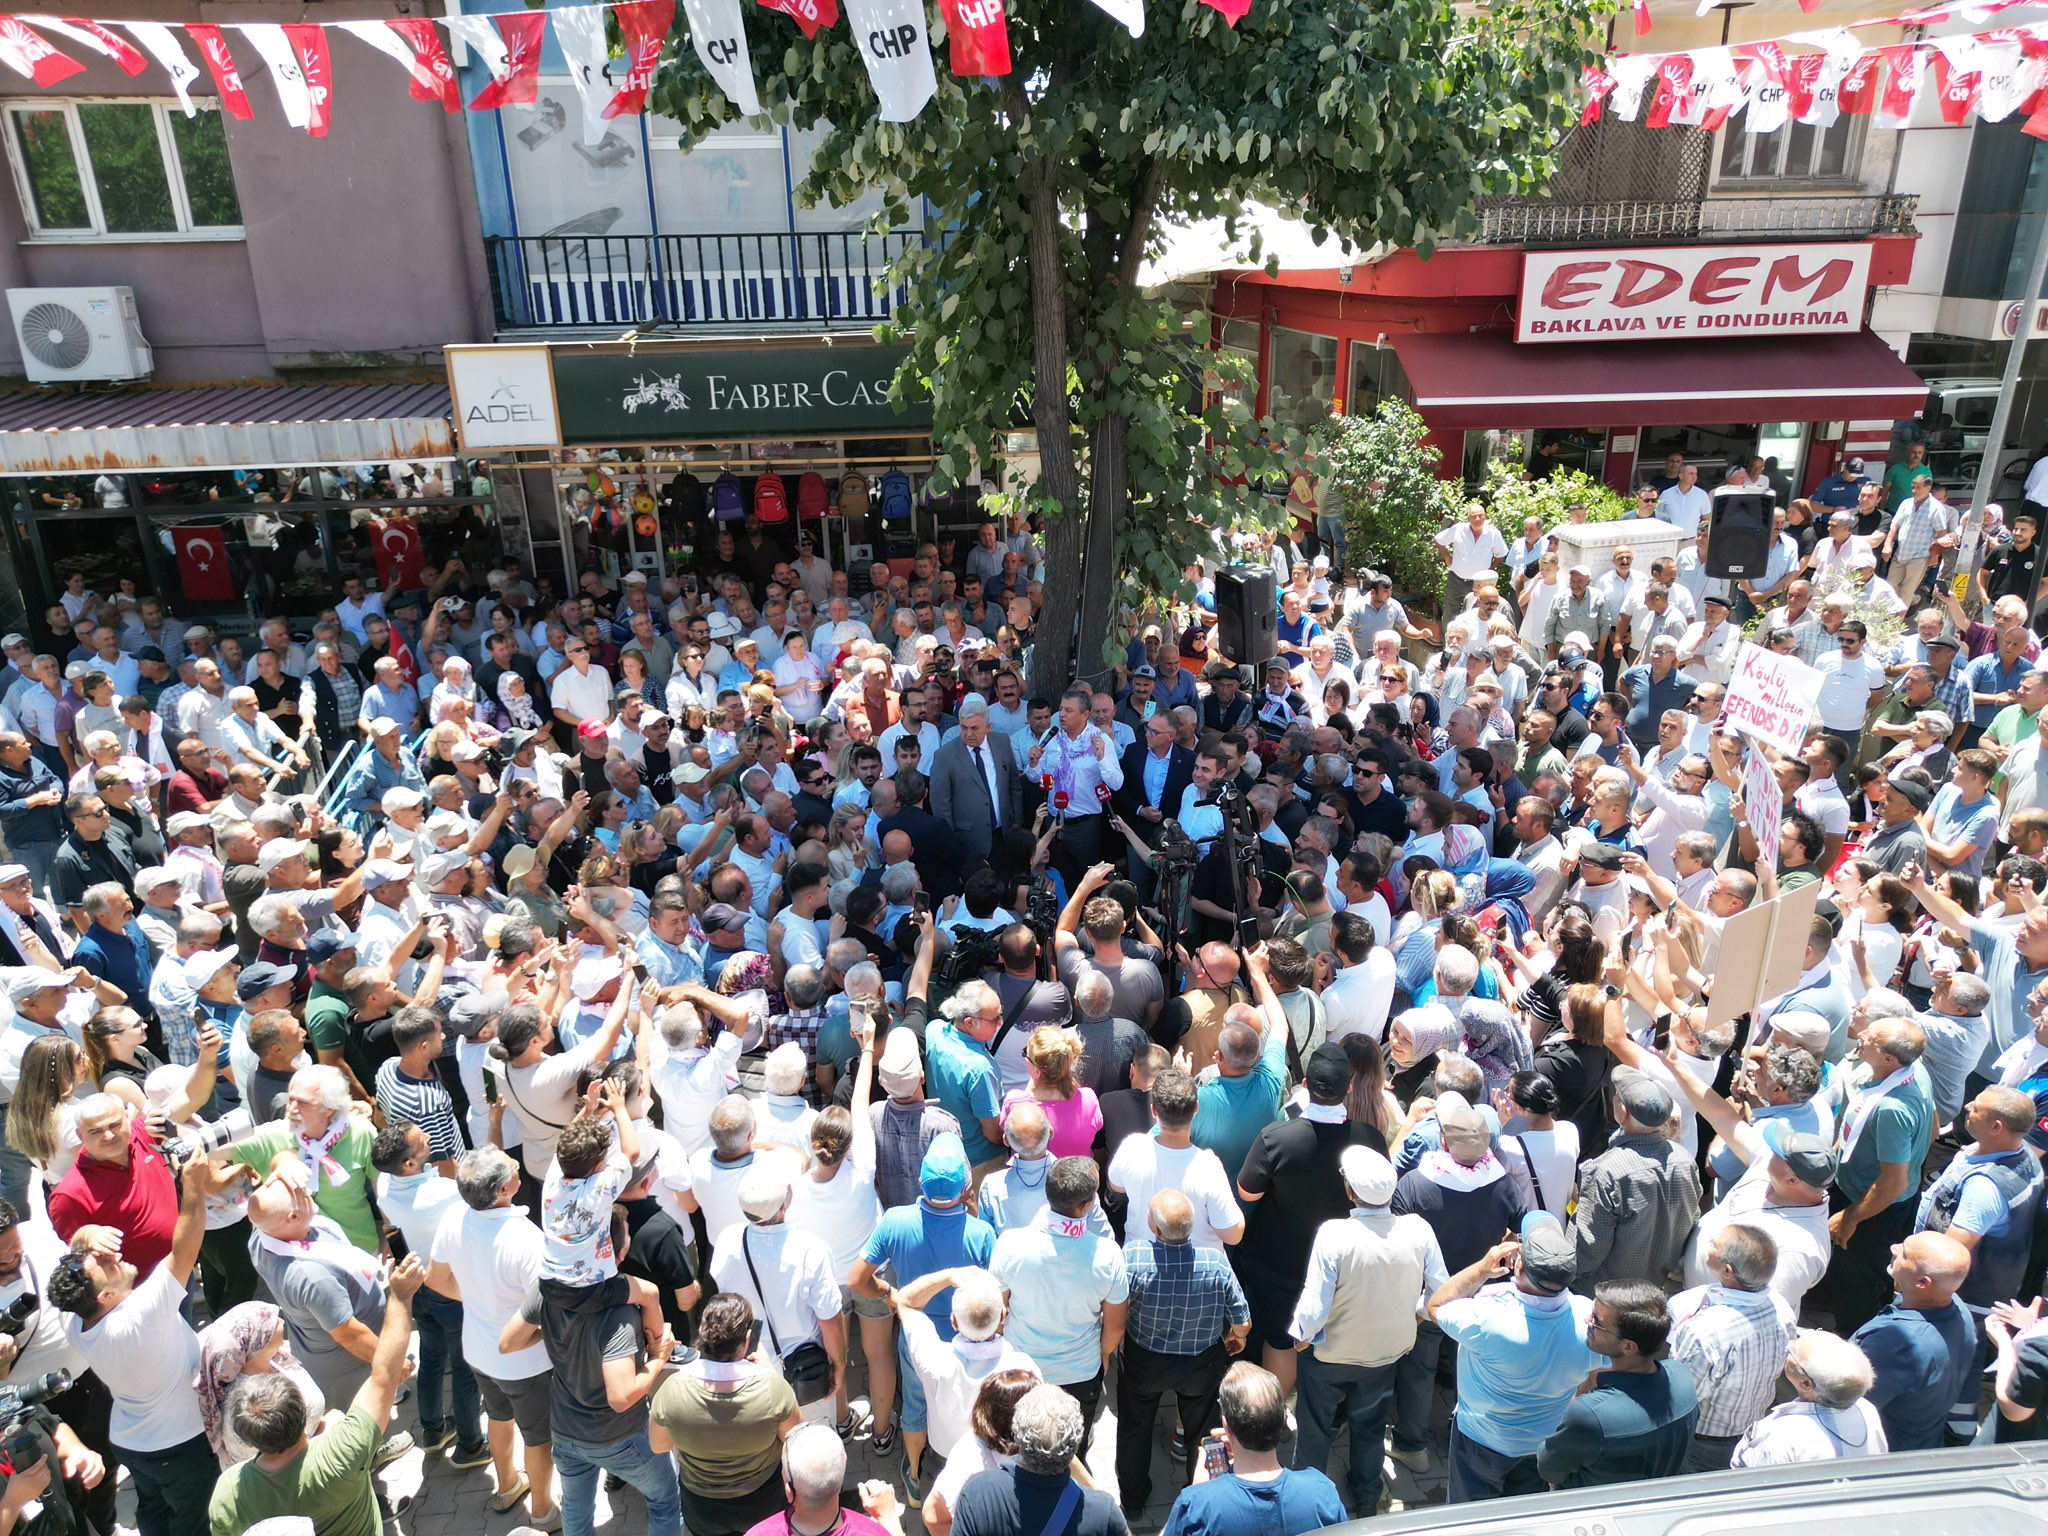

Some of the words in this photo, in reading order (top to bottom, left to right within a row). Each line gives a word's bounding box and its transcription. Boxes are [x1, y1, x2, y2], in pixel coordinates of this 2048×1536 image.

[957, 0, 1001, 29] CHP
[707, 38, 738, 65] CH
[869, 24, 918, 59] CHP
[1949, 87, 1970, 102] CHP
[1541, 255, 1853, 309] EDEM
[1531, 316, 1644, 335] BAKLAVA
[1656, 315, 1687, 331] VE
[1697, 310, 1849, 329] DONDURMA
[467, 404, 547, 424] ADEL
[1743, 650, 1787, 690] Köylü
